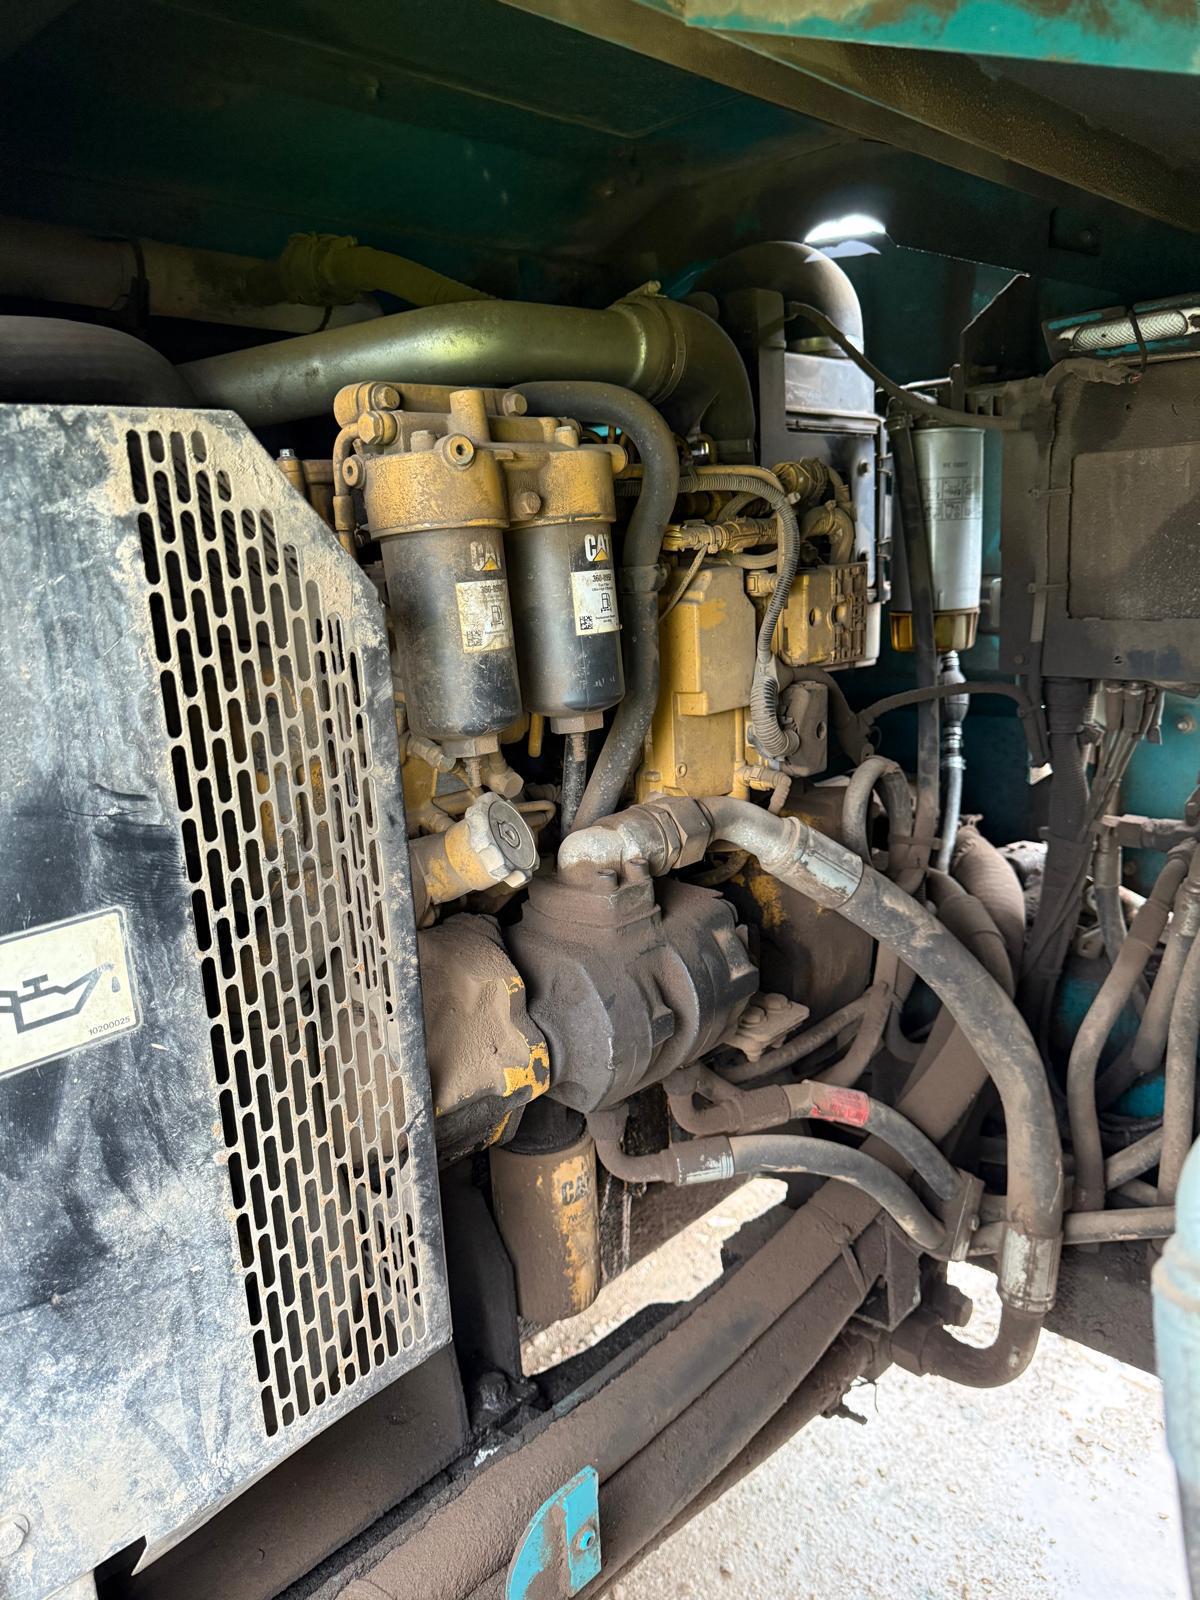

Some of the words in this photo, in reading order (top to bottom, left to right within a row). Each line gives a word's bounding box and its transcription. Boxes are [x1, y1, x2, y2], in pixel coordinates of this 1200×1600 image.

[584, 533, 610, 562] CAT
[89, 1016, 131, 1036] 10200025
[562, 1171, 589, 1206] CA
